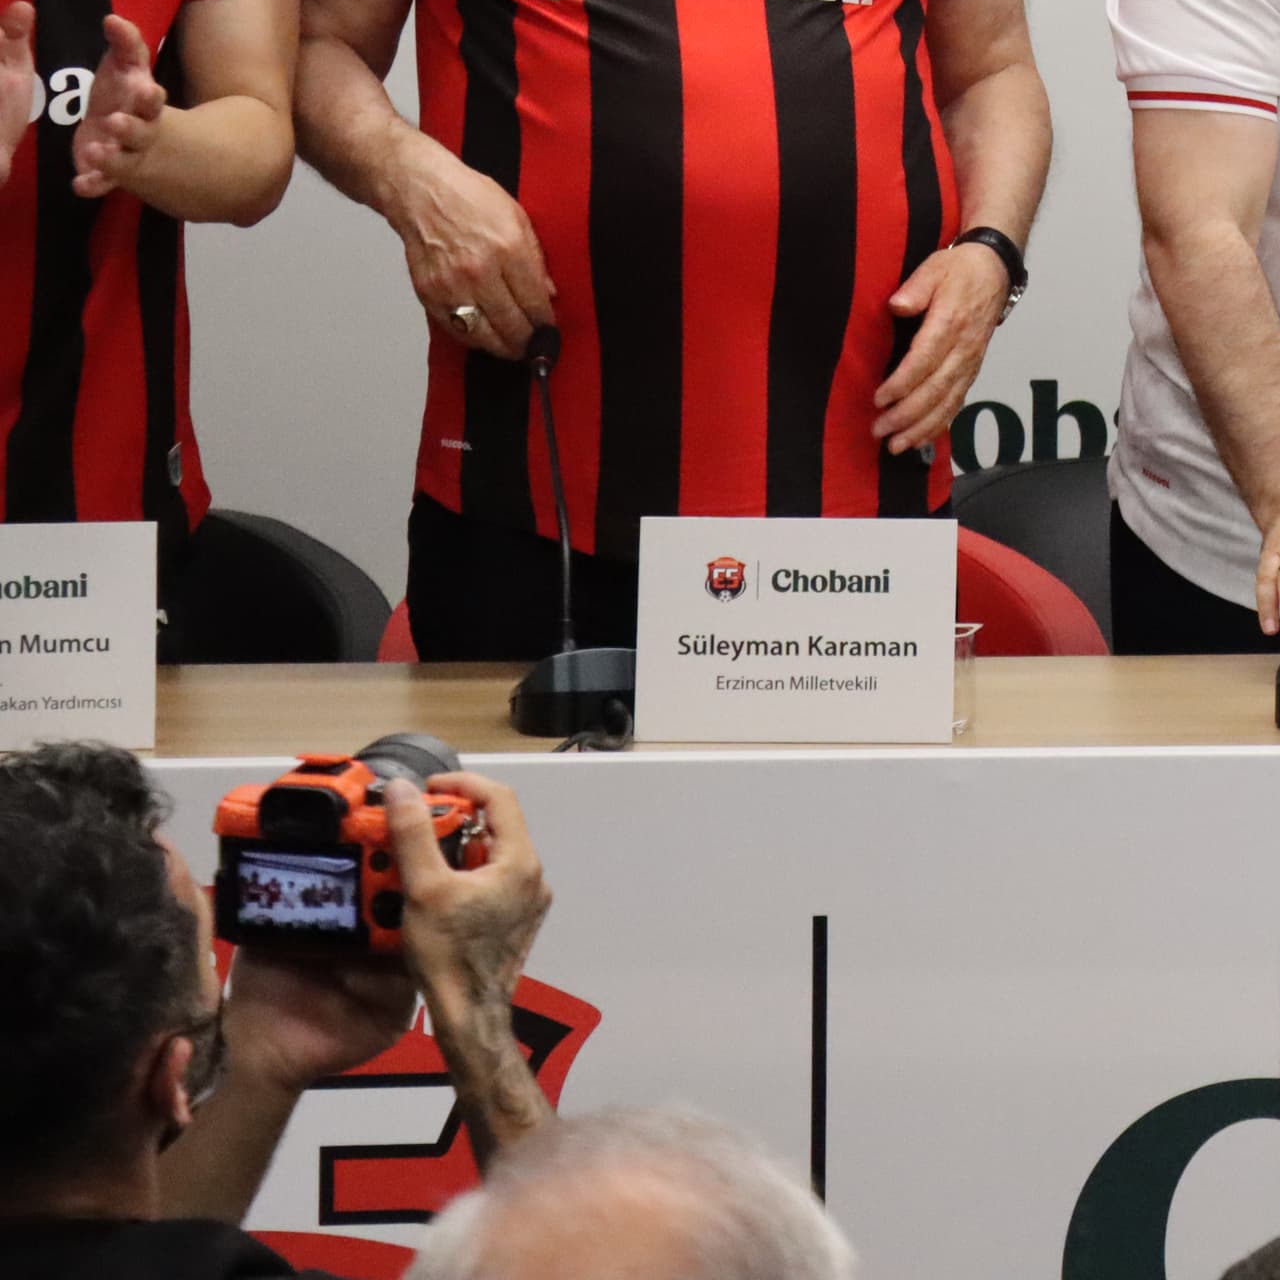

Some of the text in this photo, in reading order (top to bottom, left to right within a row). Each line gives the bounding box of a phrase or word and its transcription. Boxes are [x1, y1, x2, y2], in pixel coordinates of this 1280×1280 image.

[0, 572, 88, 601] obani
[771, 568, 891, 594] Chobani
[19, 633, 110, 655] Mumcu
[677, 633, 918, 662] Süleyman Karaman
[715, 675, 878, 692] Erzincan Milletvekili
[41, 695, 122, 711] Yardımcısı
